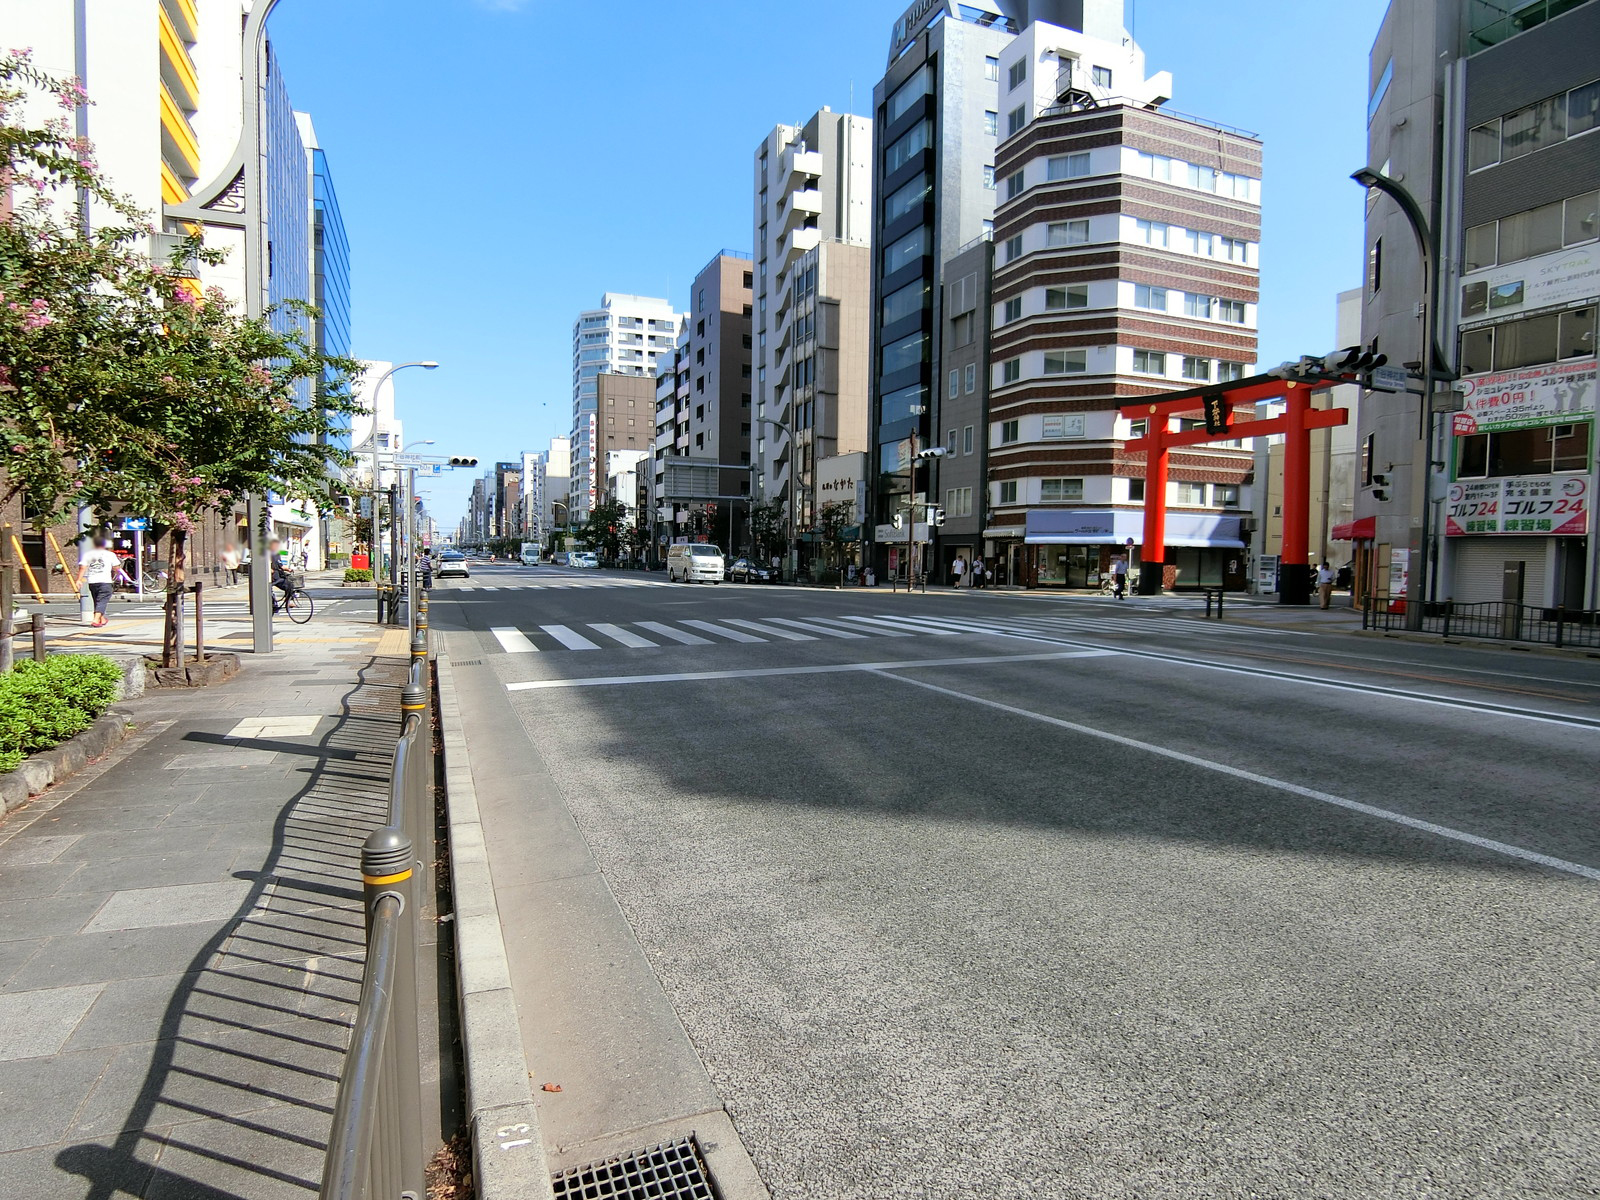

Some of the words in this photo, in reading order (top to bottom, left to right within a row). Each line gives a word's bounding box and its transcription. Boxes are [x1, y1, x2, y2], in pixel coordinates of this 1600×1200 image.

[908, 0, 939, 30] HULI
[1505, 488, 1552, 497] 完全個室
[1449, 501, 1497, 517] ゴルフ24
[1505, 499, 1585, 515] ゴルフ24
[1466, 519, 1498, 532] 練習場
[1503, 518, 1552, 532] 練習場
